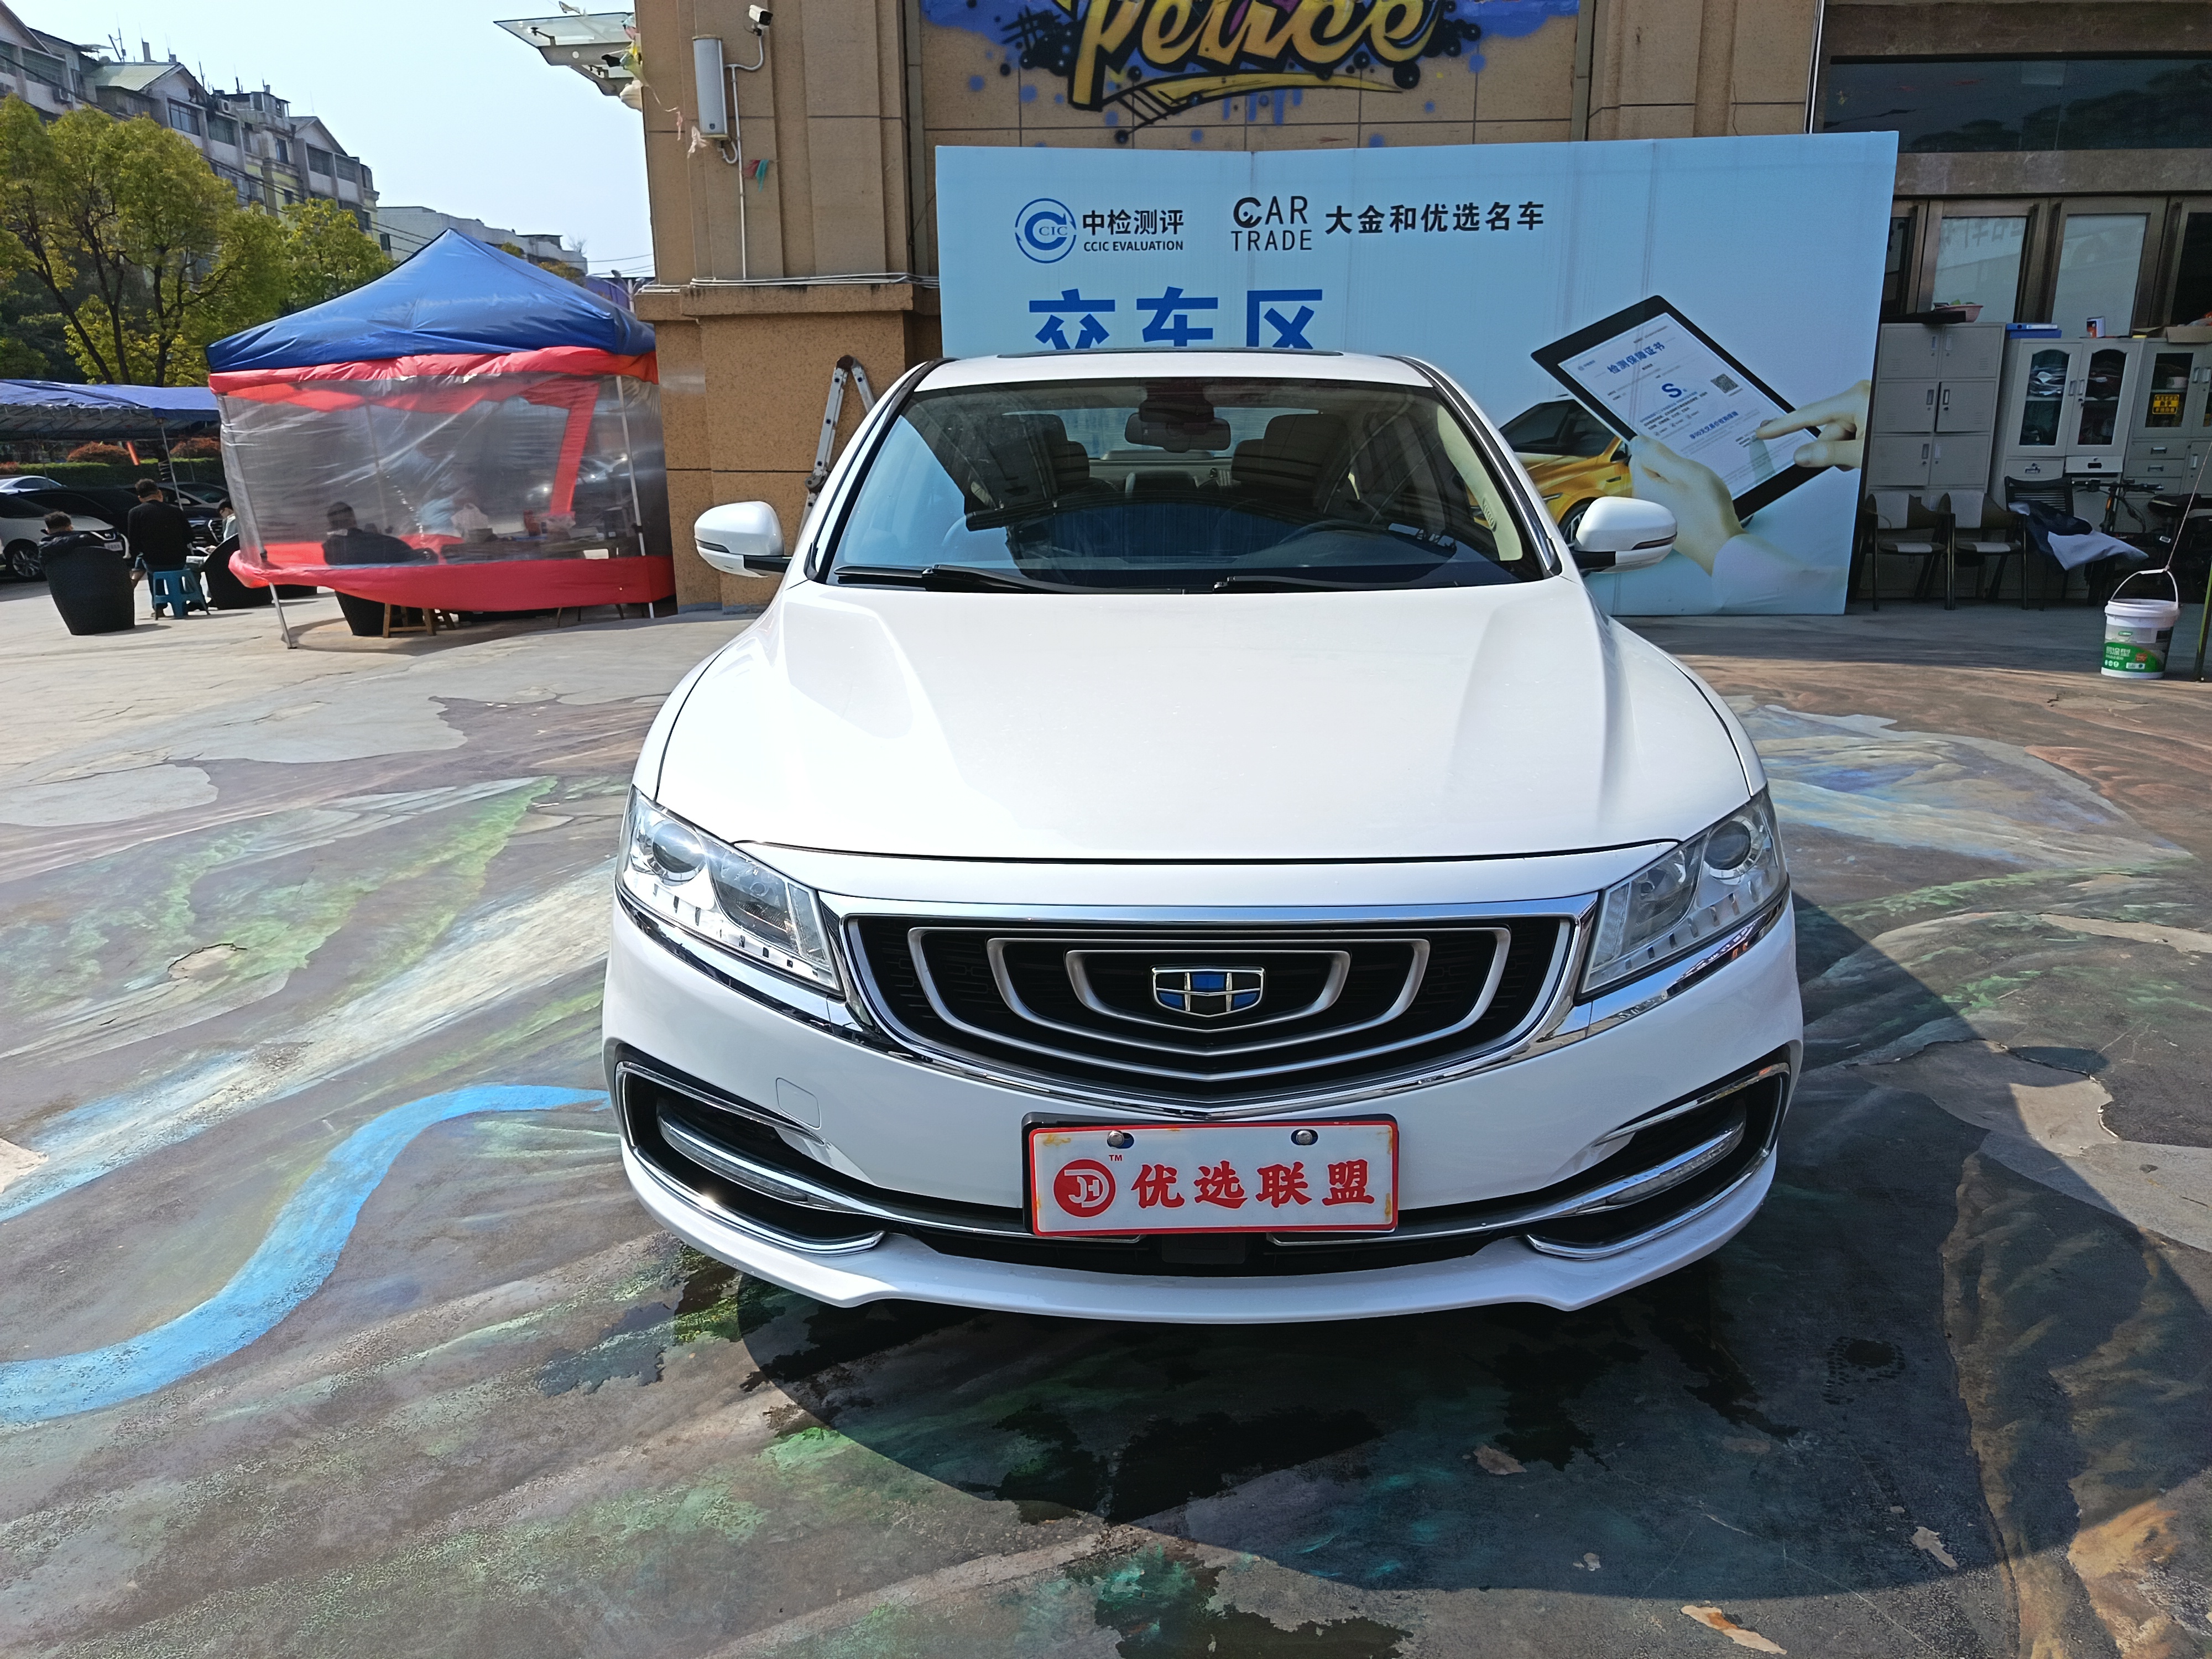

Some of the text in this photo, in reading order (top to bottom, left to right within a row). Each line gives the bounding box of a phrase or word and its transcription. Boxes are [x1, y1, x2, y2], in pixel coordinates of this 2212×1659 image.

[1082, 209, 1185, 236] 中检测评
[1233, 195, 1308, 226] CAR
[1325, 201, 1545, 234] 大金和优选名车
[1083, 240, 1184, 252] CCIC EVALUATION
[1230, 230, 1313, 251] TRADE
[1606, 341, 1666, 375] 检测保障证书
[1661, 382, 1682, 398] S
[1131, 1159, 1375, 1210] 优选联盟
